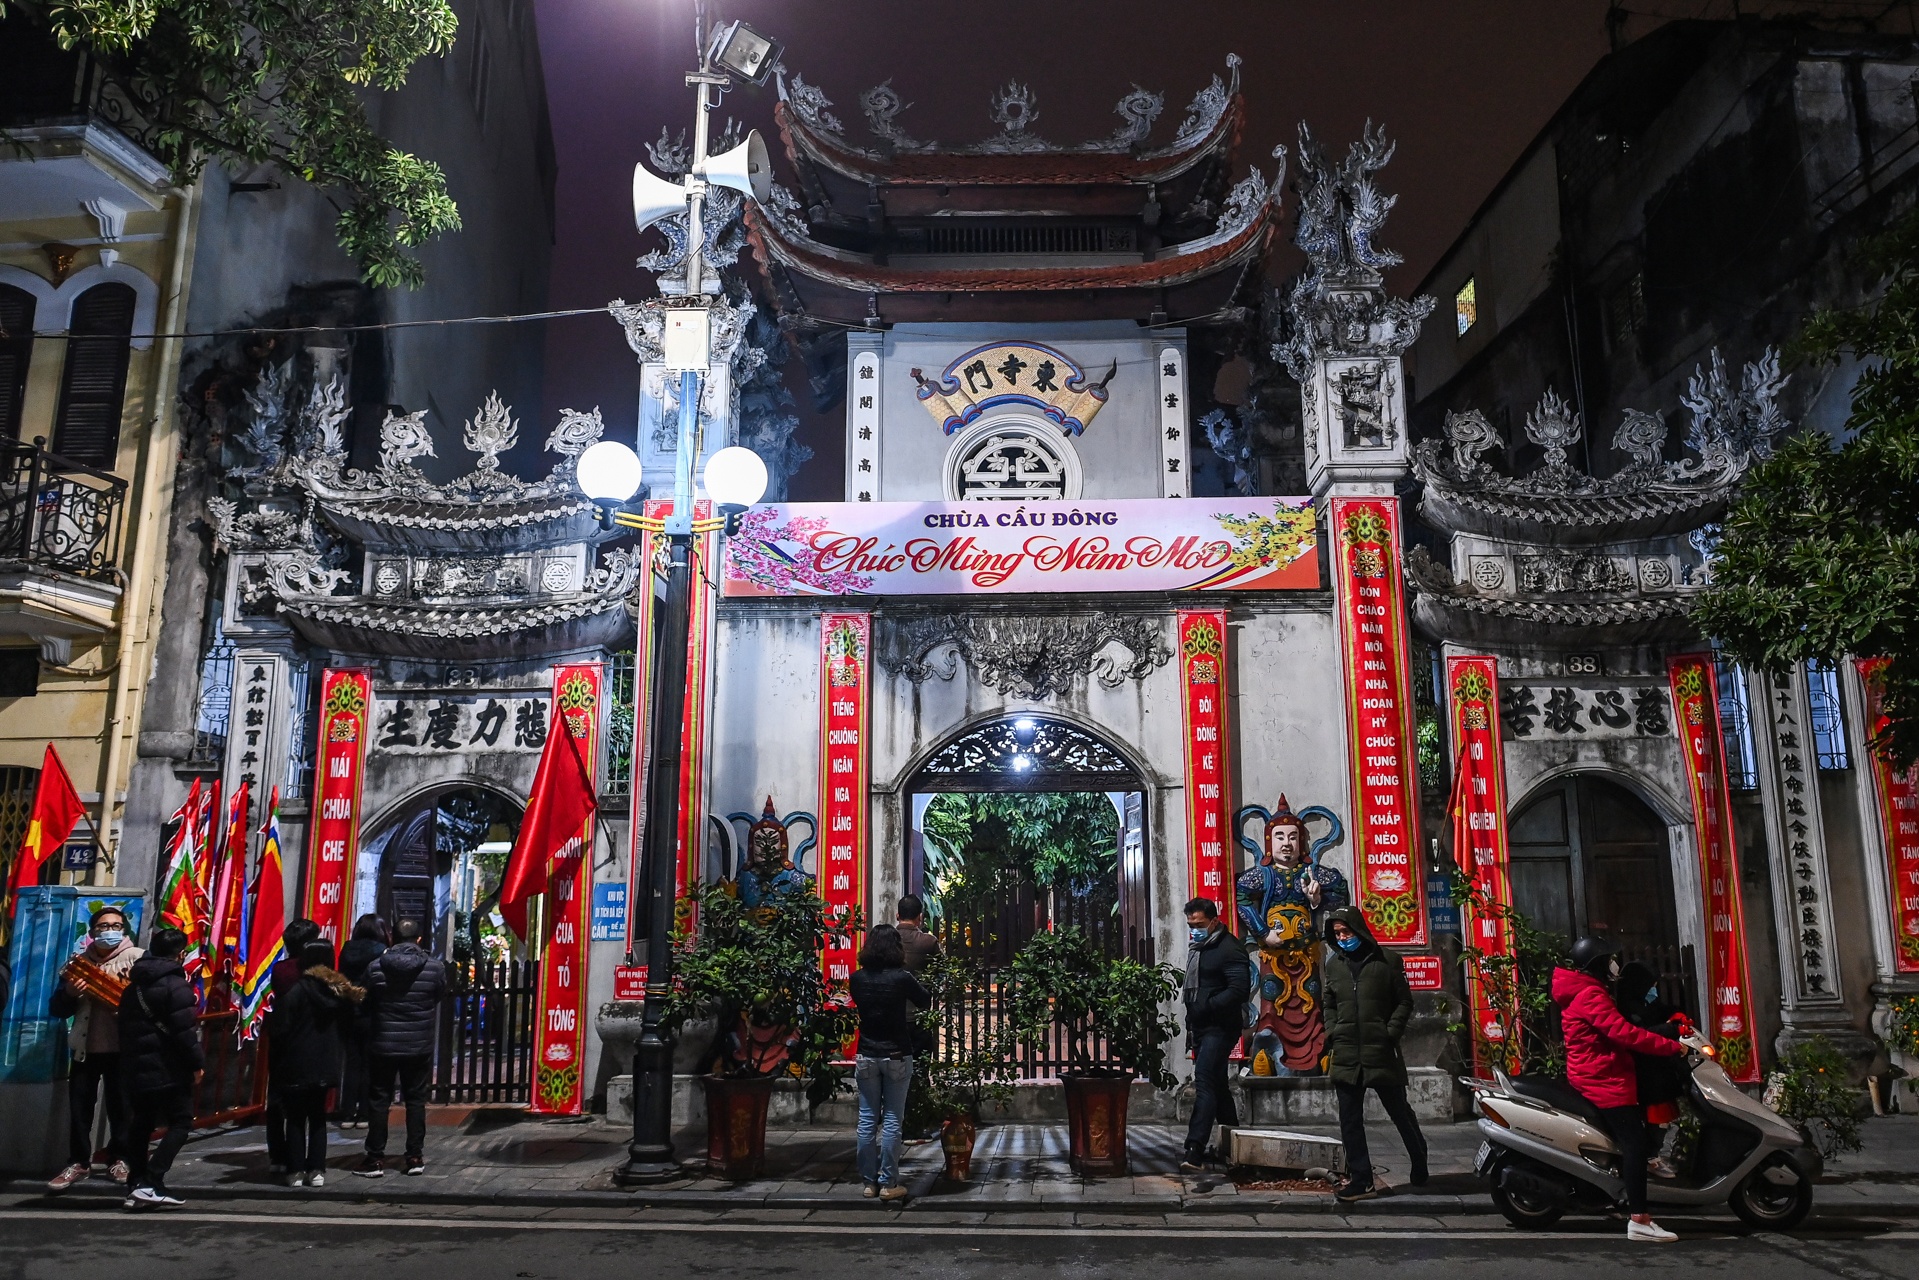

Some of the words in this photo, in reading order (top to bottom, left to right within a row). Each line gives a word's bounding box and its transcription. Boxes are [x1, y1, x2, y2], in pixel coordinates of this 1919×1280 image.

[924, 510, 991, 528] CHÙA
[996, 506, 1046, 527] CẦU
[1052, 509, 1118, 527] ĐÔNG
[810, 530, 904, 572] Chúc
[905, 535, 1024, 587] Mừng
[1023, 535, 1133, 571] Năm
[1360, 586, 1380, 597] ĐÓN
[1357, 603, 1385, 616] CHÀO
[1361, 622, 1384, 634] NĂM
[1364, 640, 1383, 652] MỚI
[1364, 658, 1386, 671] NHÀ
[1570, 656, 1597, 673] 38
[1365, 677, 1388, 690] NHÀ
[832, 696, 855, 716] TIẾNG
[1199, 697, 1212, 713] ĐÔI
[1363, 698, 1393, 709] HOAN
[829, 727, 858, 745] CHUÔNG
[1197, 724, 1217, 741] DÒNG
[1366, 734, 1395, 748] CHÚC
[330, 752, 350, 778] MÁI
[833, 755, 853, 773] NGÂN
[1202, 752, 1214, 774] KỆ
[1366, 756, 1397, 770] TỤNG
[835, 787, 850, 802] NGA
[1199, 784, 1219, 803] TỤNG
[1374, 795, 1394, 806] VUI
[323, 794, 350, 820] CHÙA
[832, 810, 851, 831] LẮNG
[1204, 810, 1217, 828] ÂM
[1370, 810, 1401, 825] KHẮP
[1374, 831, 1399, 845] NẺO
[69, 848, 95, 864] 42
[322, 840, 344, 861] CHE
[831, 845, 852, 865] ĐỌNG
[1201, 842, 1222, 857] VANG
[1368, 851, 1408, 865] ĐƯỜNG
[1472, 774, 1487, 795] TÔN
[1482, 919, 1497, 943] MỌI
[1204, 869, 1221, 890] DIỆU
[556, 915, 574, 944] CỦA
[591, 921, 608, 939] CẤM
[557, 955, 570, 987] TỔ
[1716, 981, 1740, 1006] SỐNG
[548, 1004, 575, 1032] TÔNG
